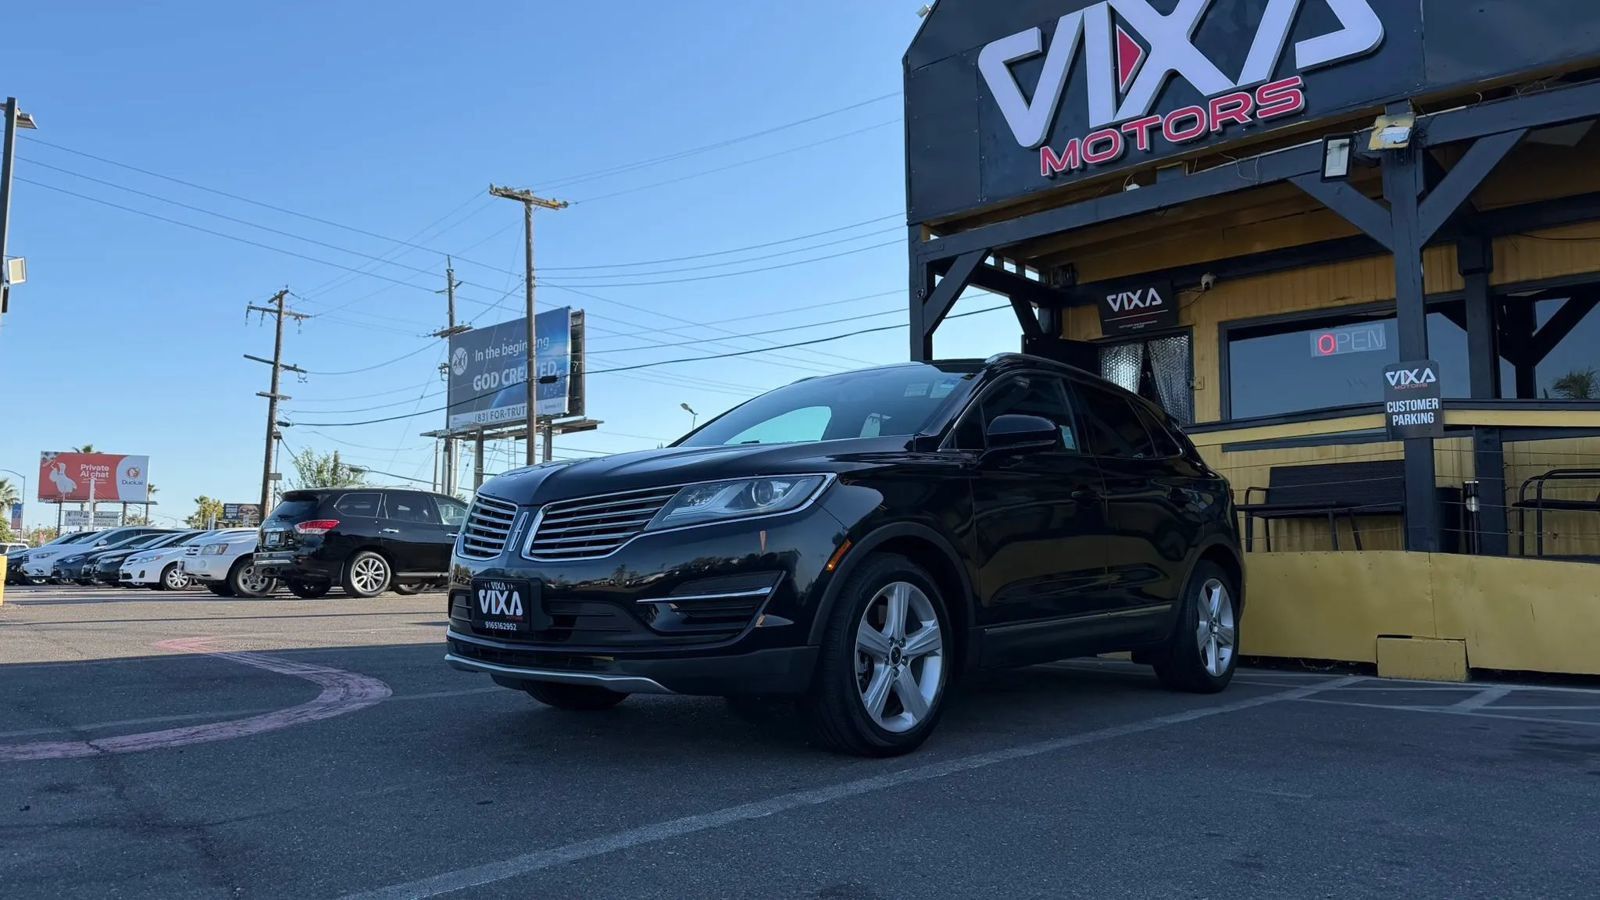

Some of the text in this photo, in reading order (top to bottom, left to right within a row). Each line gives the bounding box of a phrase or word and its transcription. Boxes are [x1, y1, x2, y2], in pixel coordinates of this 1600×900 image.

[977, 0, 1384, 148] VIXA
[1039, 75, 1305, 178] MOTORS
[1106, 287, 1163, 312] VIXA
[475, 350, 484, 362] In
[485, 346, 500, 360] the
[501, 336, 550, 357] beginng
[1318, 328, 1383, 356] OPEN
[473, 371, 500, 392] GOD
[1385, 367, 1437, 386] VIXA
[490, 406, 526, 421] FOR-TRUT
[1386, 398, 1439, 413] CUSTOMER
[1392, 412, 1435, 426] PARKING
[80, 463, 110, 472] Private
[90, 471, 109, 479] chat
[478, 590, 523, 616] VIXA
